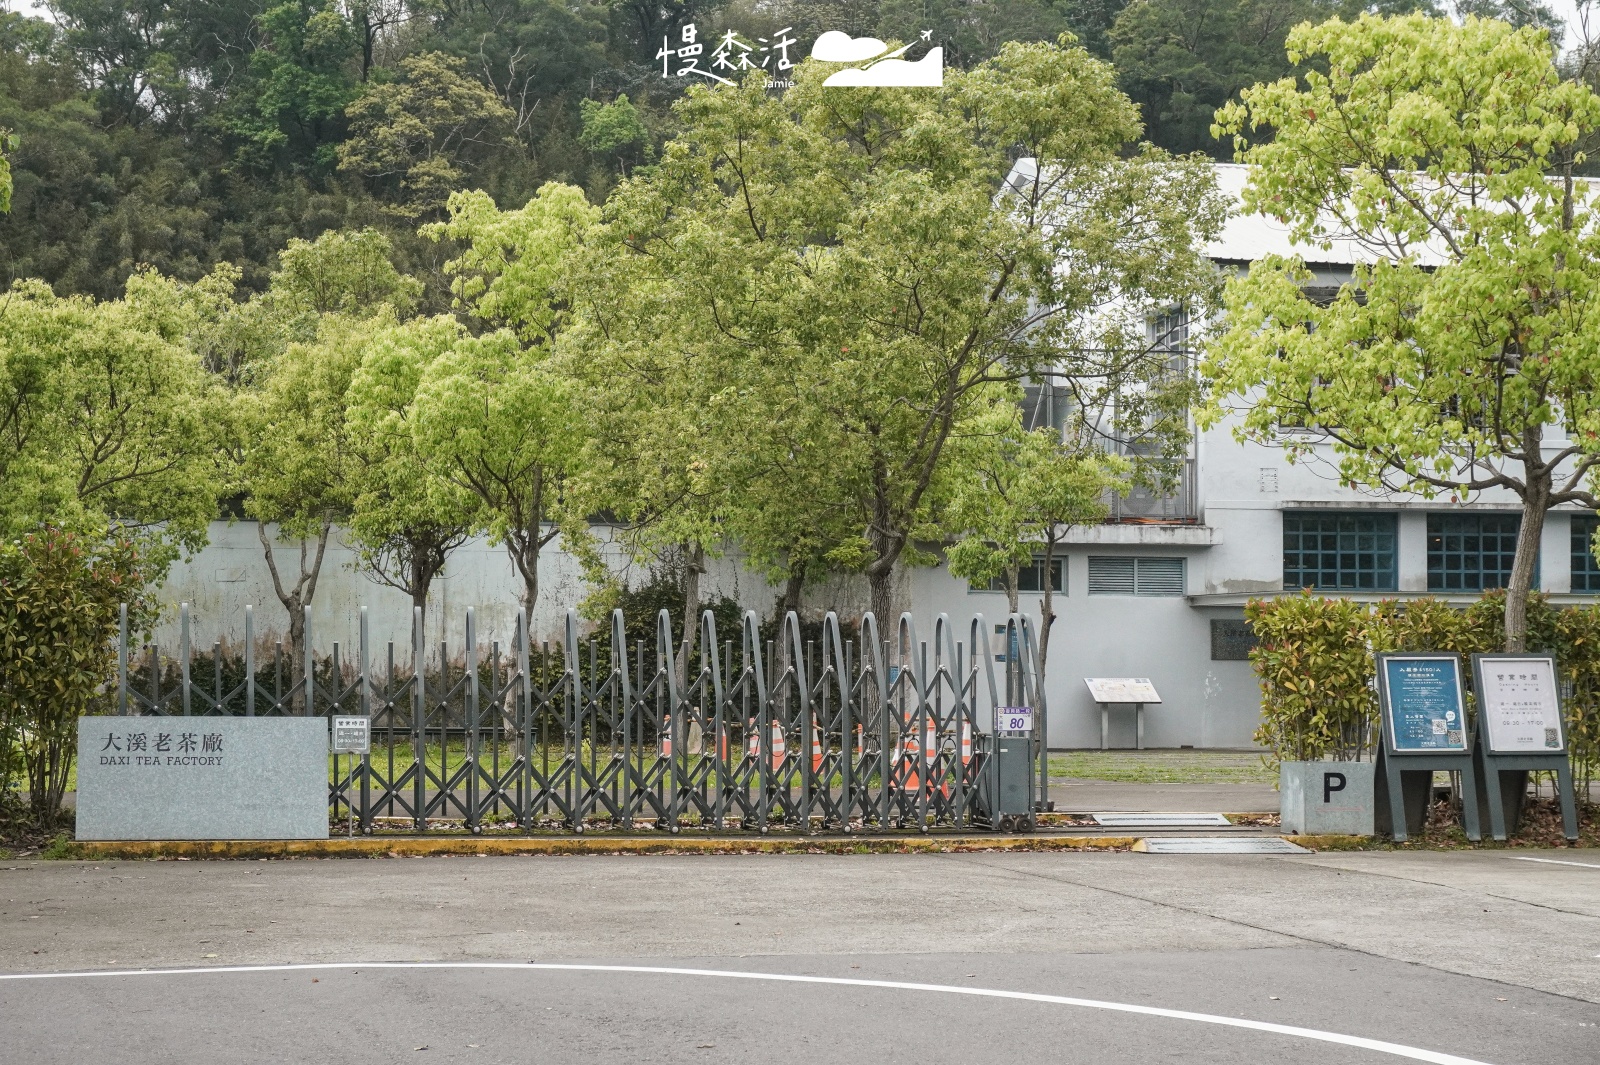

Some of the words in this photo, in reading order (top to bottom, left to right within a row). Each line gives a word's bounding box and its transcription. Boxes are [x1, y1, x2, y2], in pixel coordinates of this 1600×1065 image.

[1010, 718, 1024, 729] 80
[100, 732, 224, 753] 大溪老茶廠
[100, 756, 130, 766] DAXI
[136, 756, 161, 766] TEA
[166, 756, 224, 766] FACTORY
[1323, 772, 1347, 804] P
